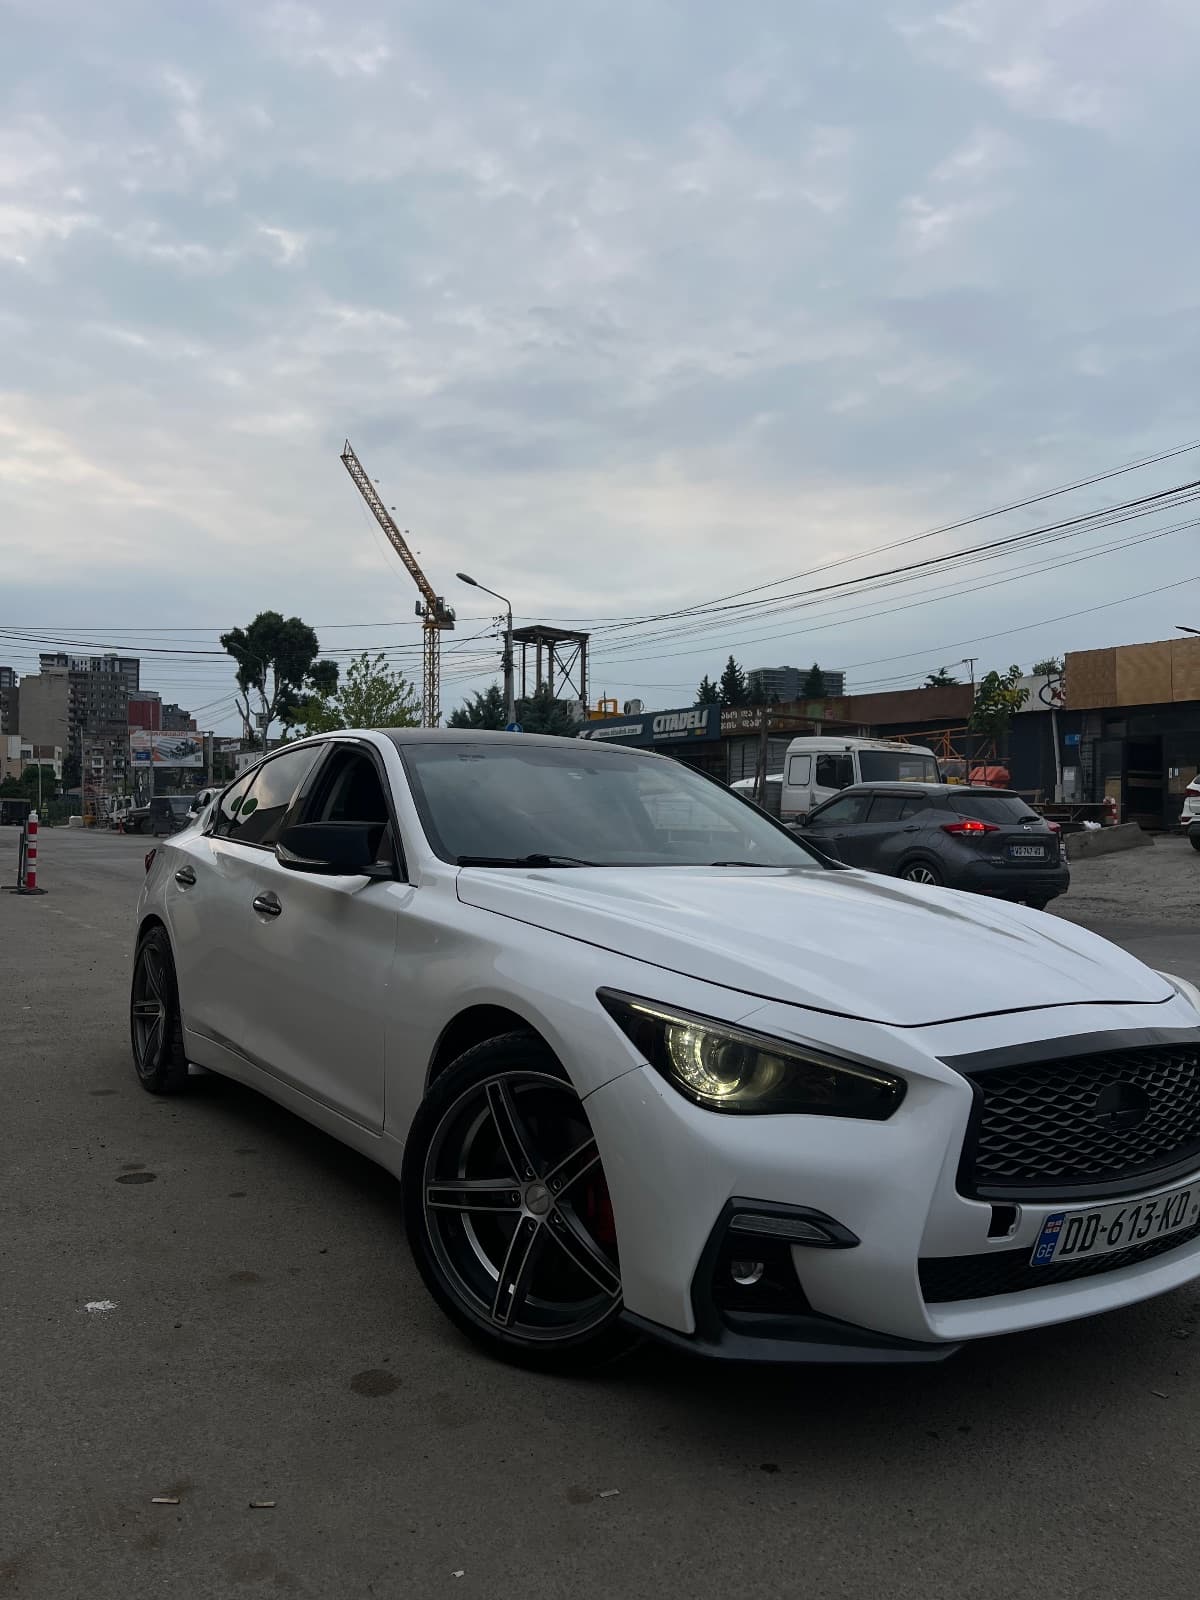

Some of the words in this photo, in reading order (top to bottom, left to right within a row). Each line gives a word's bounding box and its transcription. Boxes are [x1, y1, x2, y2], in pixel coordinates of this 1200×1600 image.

[652, 709, 709, 733] CITADELI
[1059, 1190, 1191, 1256] DD-613-KD
[1036, 1242, 1056, 1258] GE
